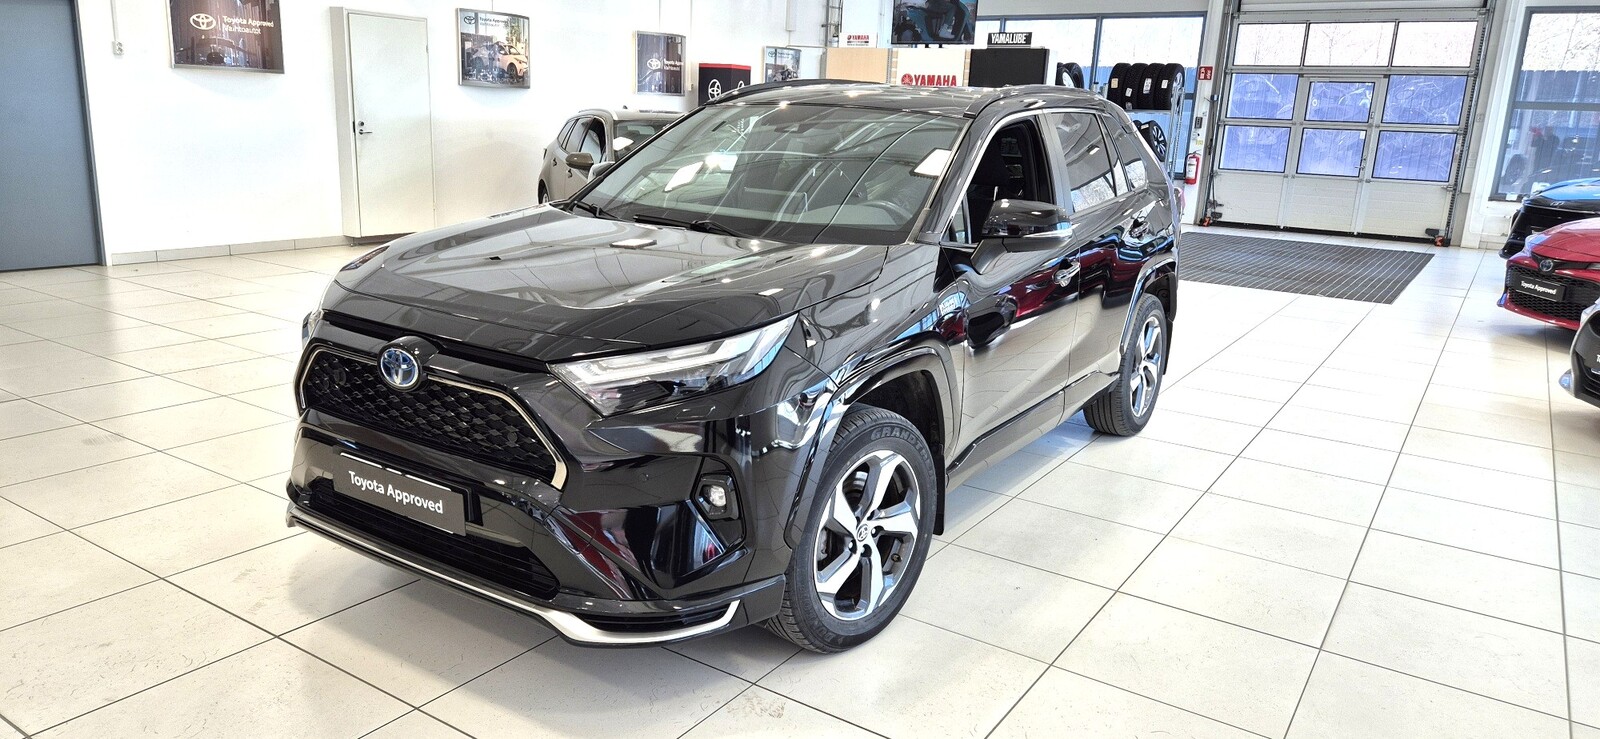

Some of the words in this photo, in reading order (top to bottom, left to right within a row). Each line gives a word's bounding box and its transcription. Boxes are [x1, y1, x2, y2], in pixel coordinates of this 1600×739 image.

[222, 15, 247, 24] Toyota
[248, 18, 274, 27] Approved
[991, 33, 1027, 44] YAMALUBE
[913, 74, 957, 87] YAMAHA
[1521, 281, 1535, 289] Toyota
[1534, 284, 1557, 295] Approved
[348, 470, 385, 494] Toyota
[386, 483, 444, 514] Approved
